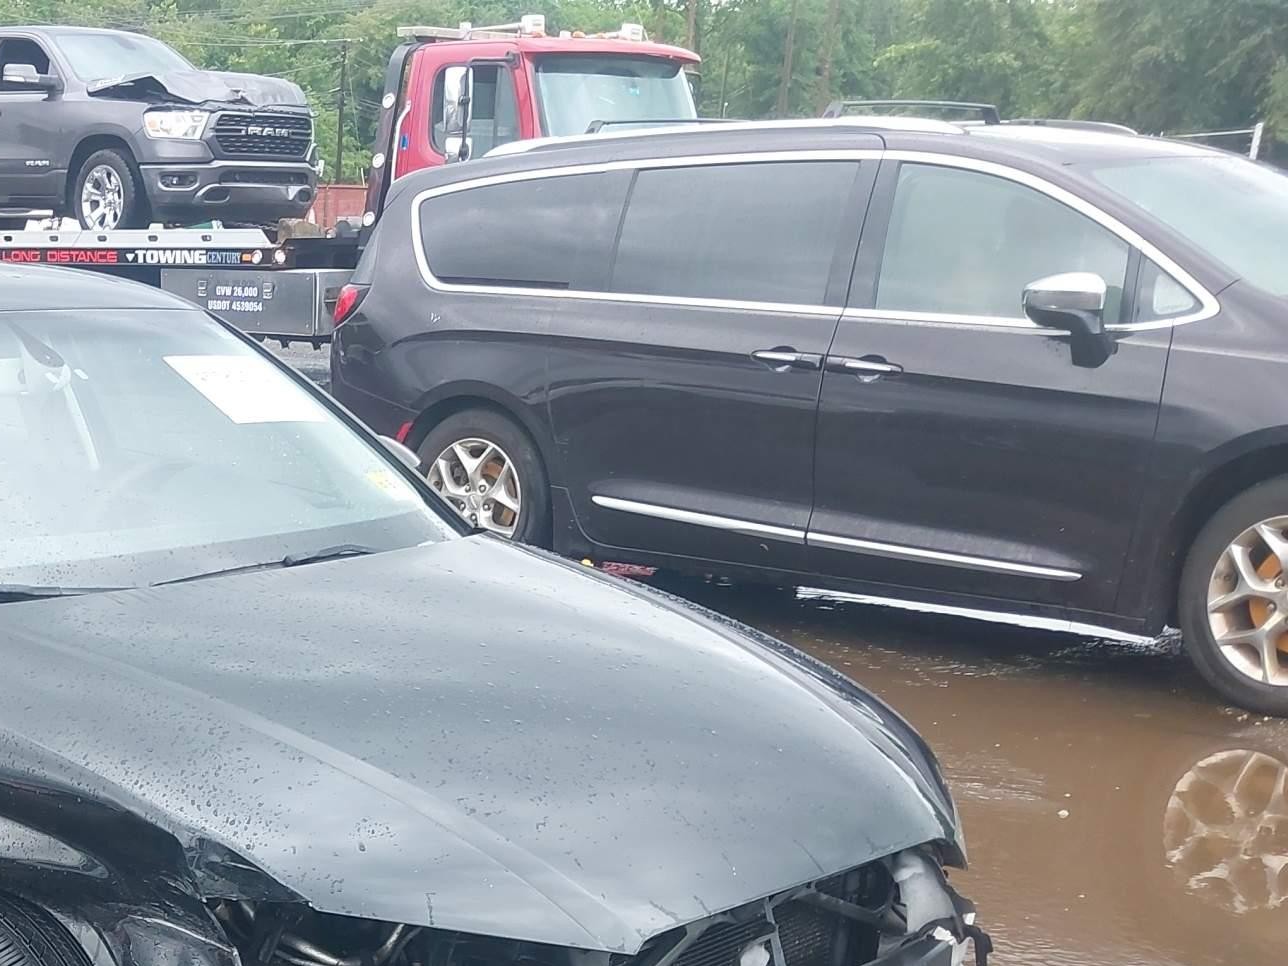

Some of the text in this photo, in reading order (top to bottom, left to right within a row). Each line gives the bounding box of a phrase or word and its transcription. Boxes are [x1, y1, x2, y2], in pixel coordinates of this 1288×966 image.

[248, 127, 289, 137] RAM
[2, 251, 41, 262] LONG
[47, 251, 118, 263] DISTANCE
[135, 250, 206, 263] TOWING
[207, 251, 241, 263] CENTURY
[216, 286, 258, 297] GVW 26,000
[208, 300, 230, 311] USDOT
